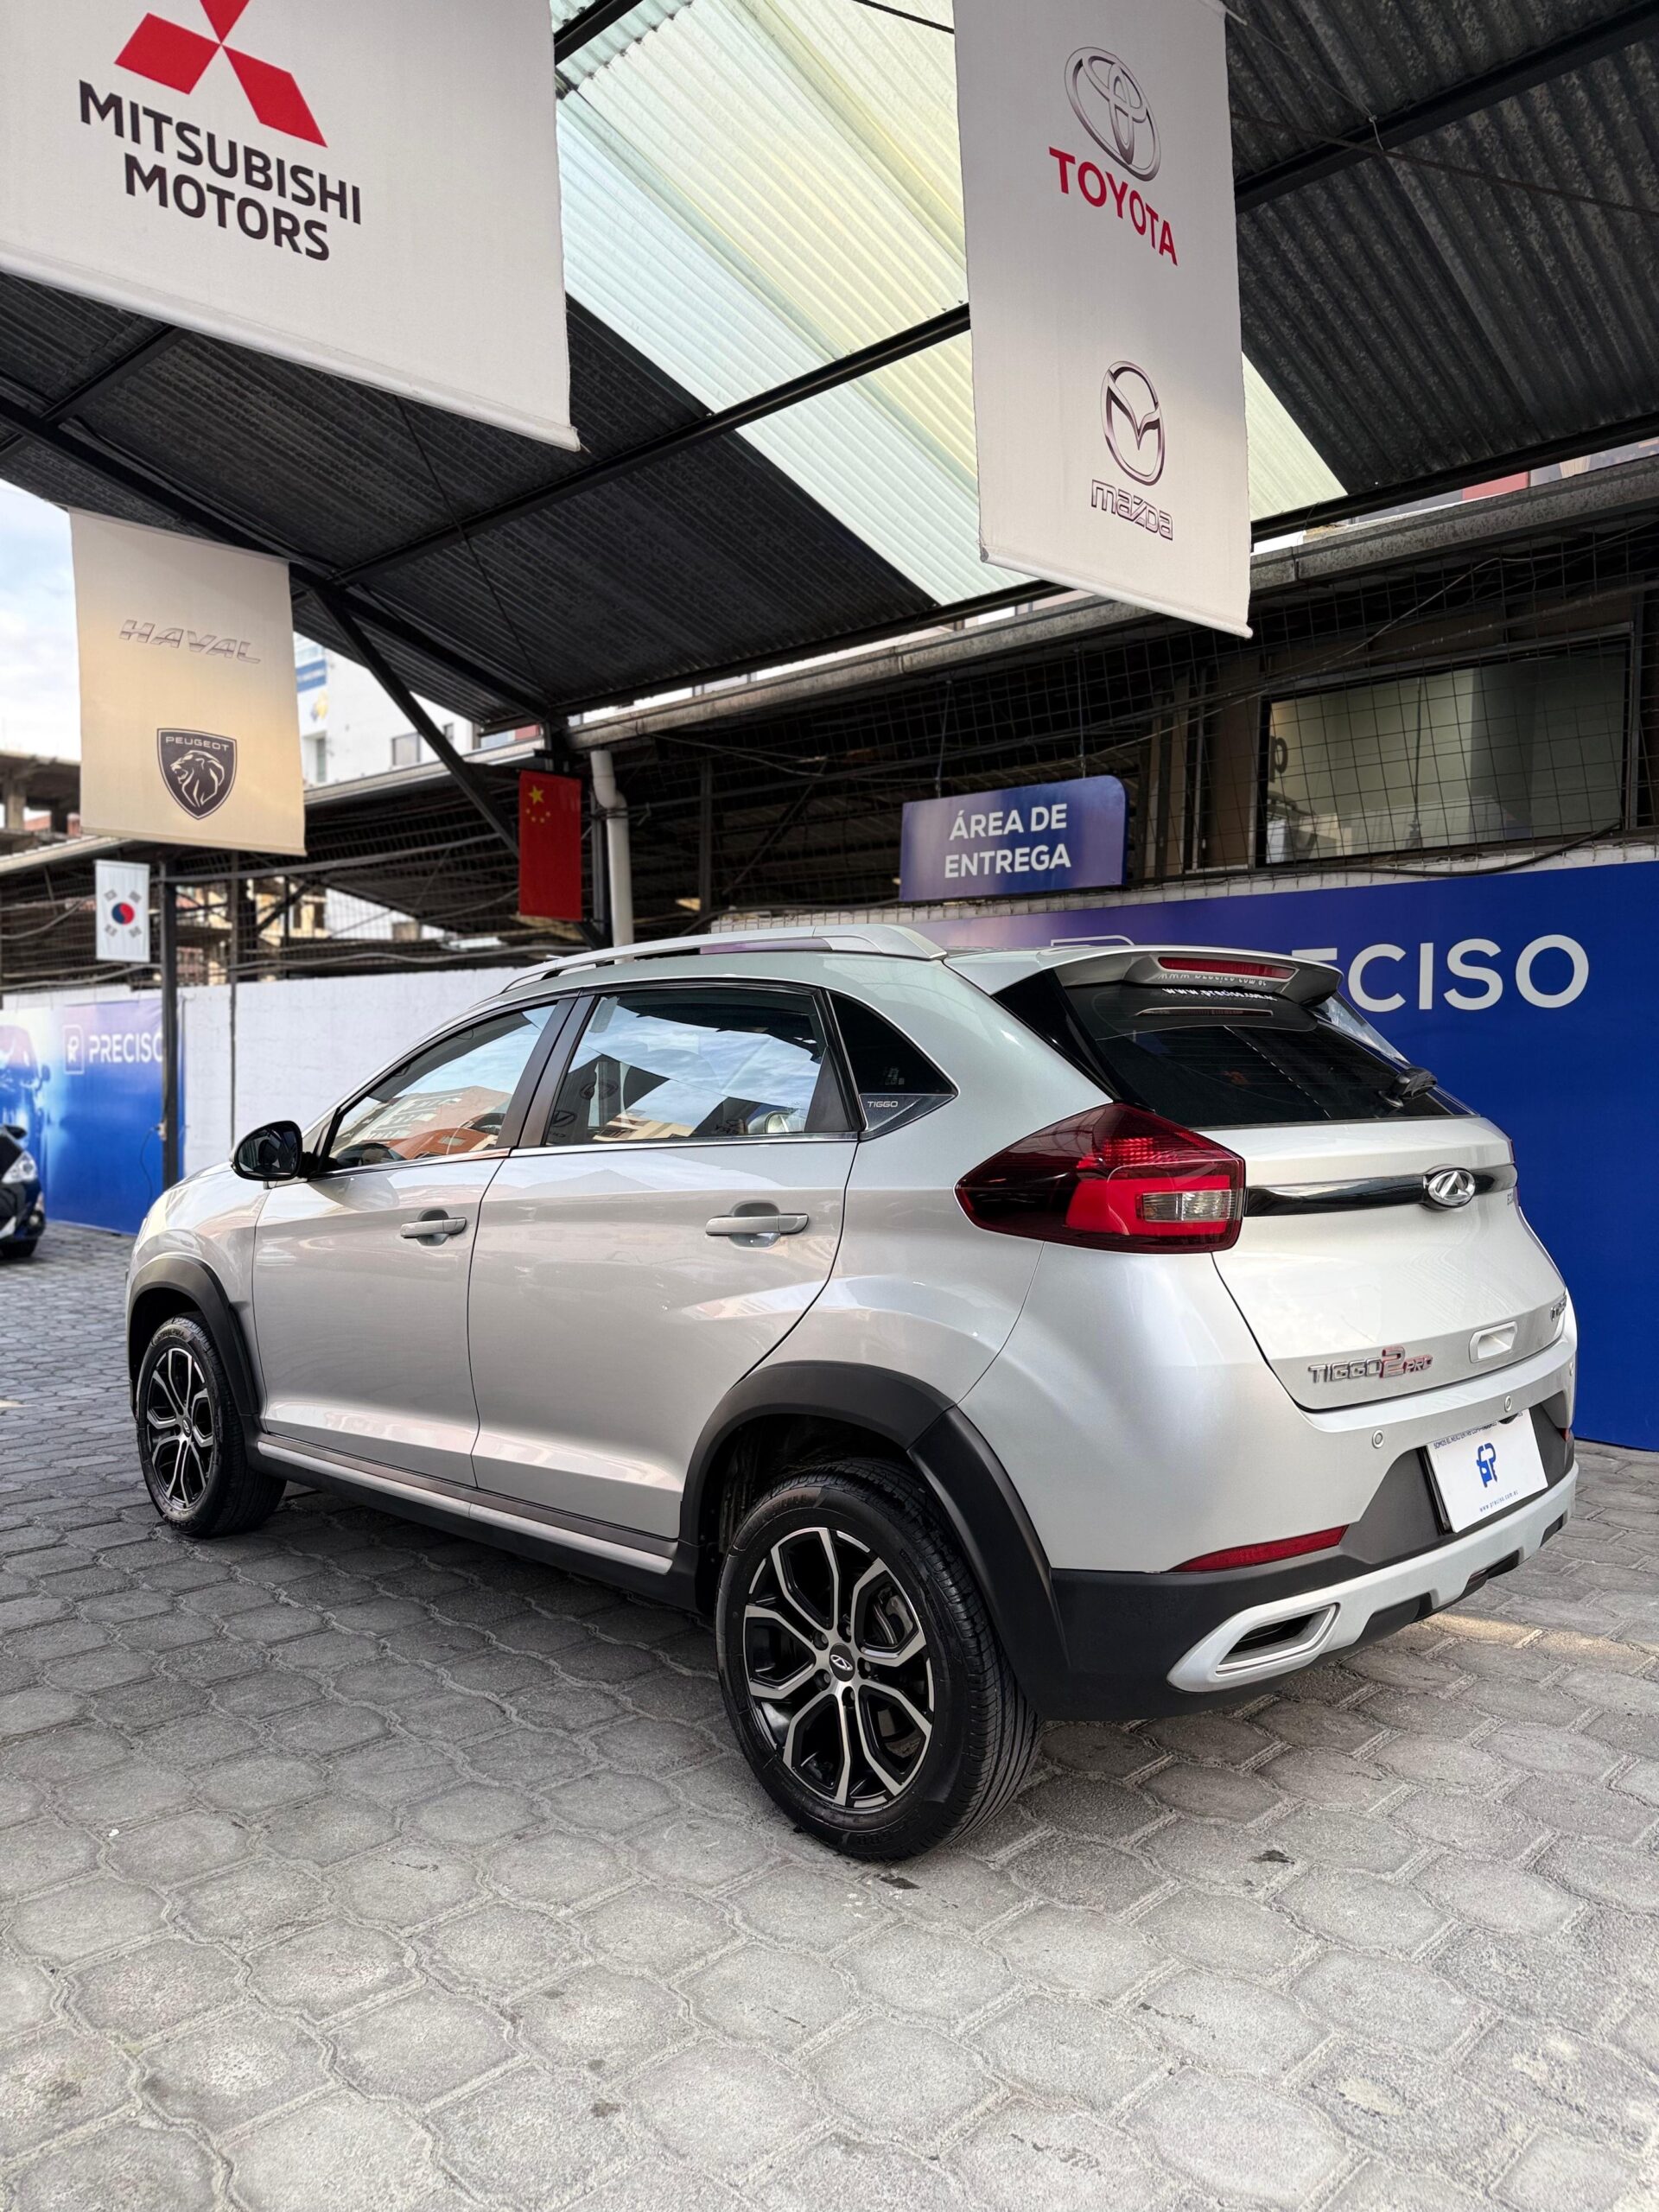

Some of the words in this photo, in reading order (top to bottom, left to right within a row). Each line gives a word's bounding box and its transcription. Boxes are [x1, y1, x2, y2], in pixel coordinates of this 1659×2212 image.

[79, 79, 361, 225] MITSUBISHI
[124, 152, 329, 261] MOTORS
[1049, 146, 1178, 266] TOYOTA
[119, 619, 261, 664] HAVAL
[165, 736, 230, 752] PEUGEOT
[949, 810, 1024, 841] ÁREA
[1031, 804, 1067, 831] DE
[944, 843, 1071, 879] ENTREGA
[1308, 1357, 1382, 1382] TIGGO
